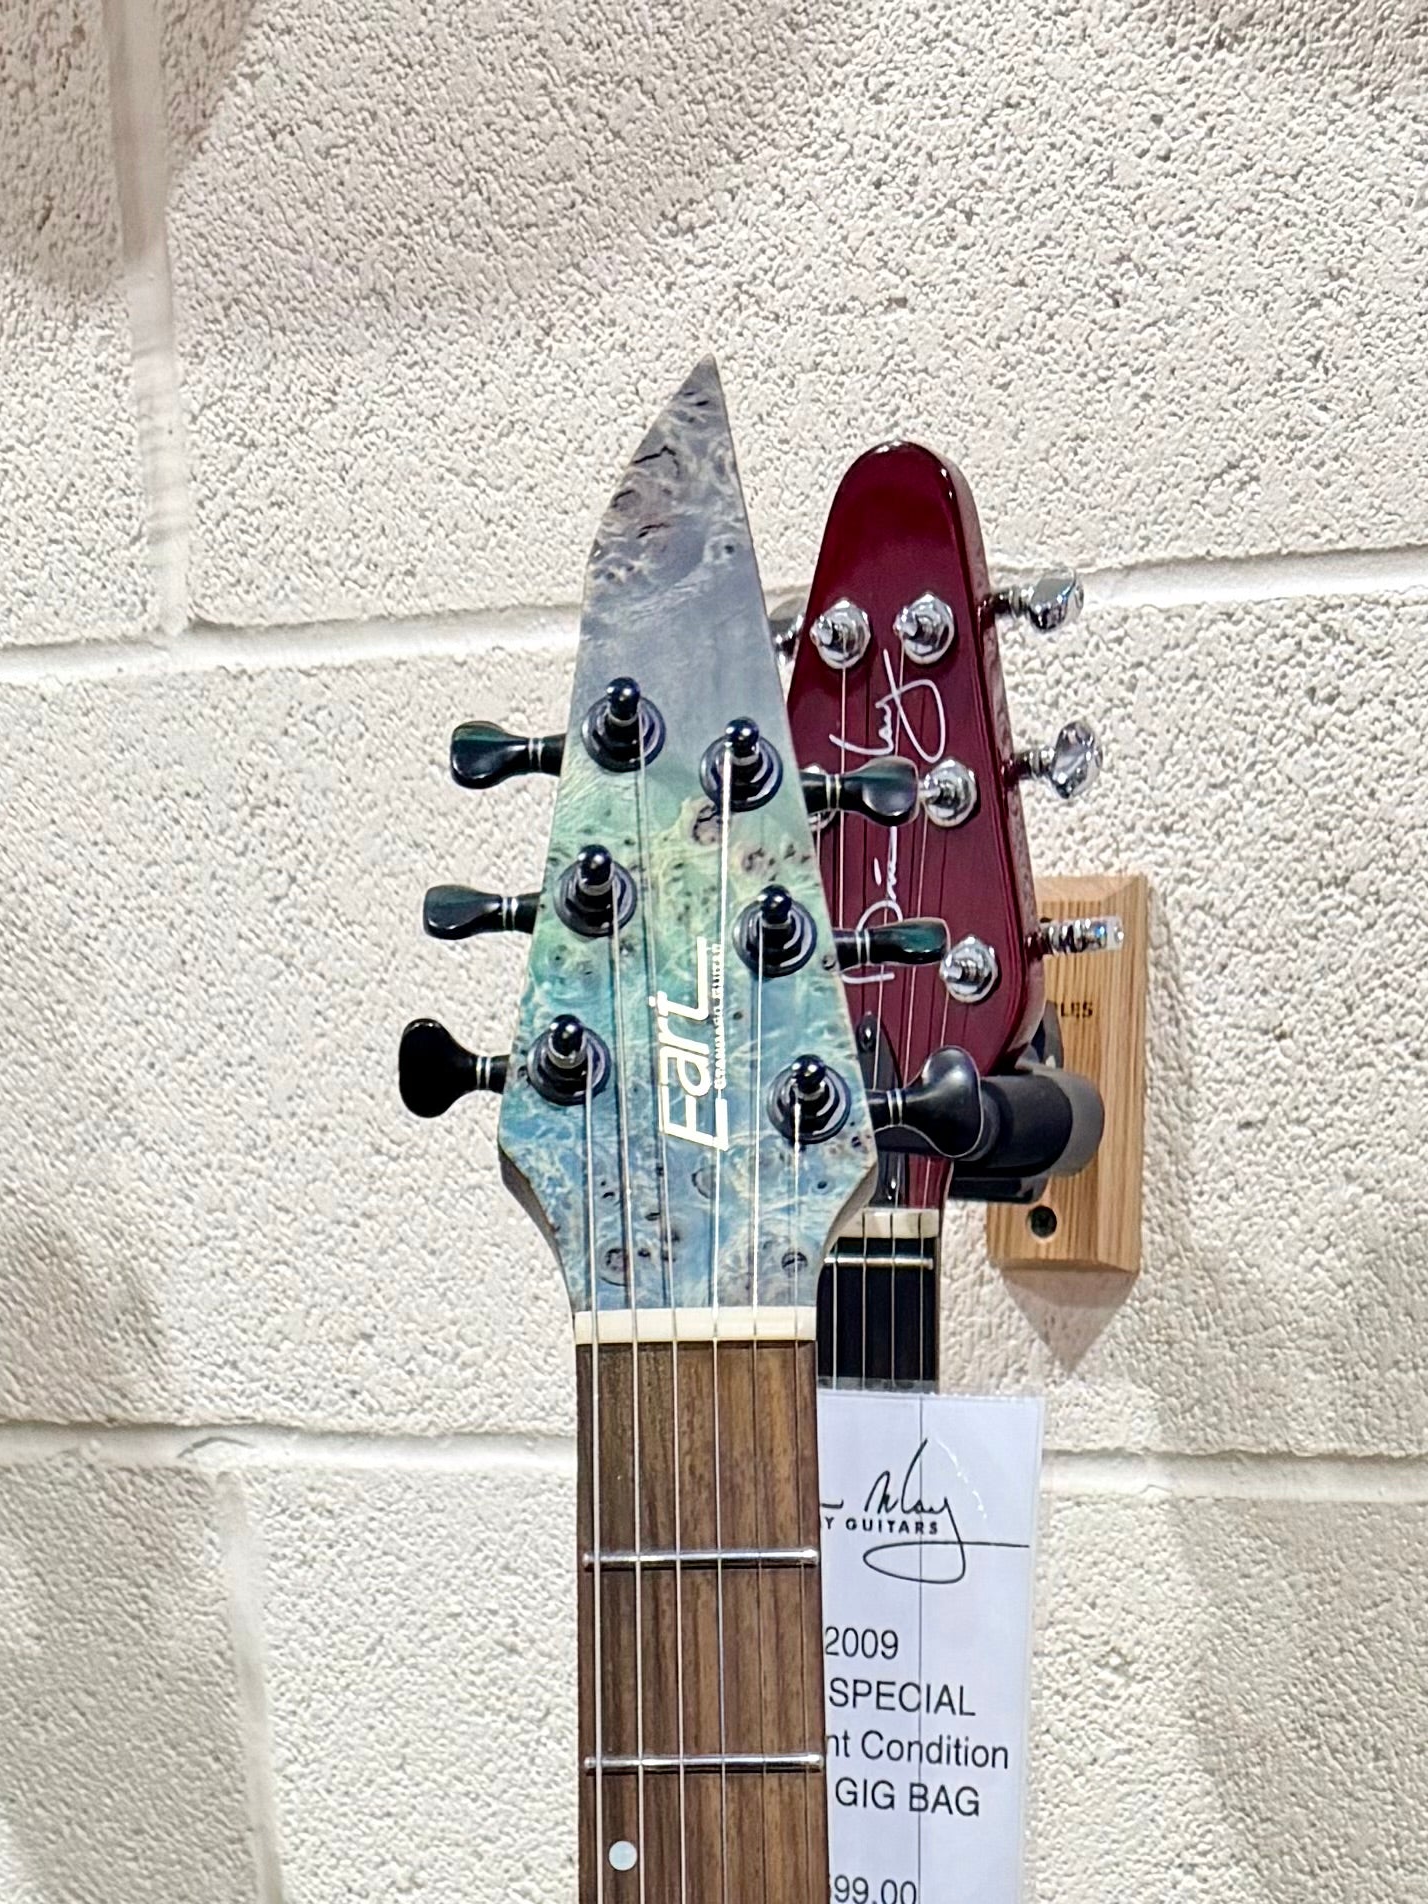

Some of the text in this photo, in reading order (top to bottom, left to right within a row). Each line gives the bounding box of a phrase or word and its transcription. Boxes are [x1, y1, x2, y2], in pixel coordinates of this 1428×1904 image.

[845, 1518, 938, 1535] GUITARS
[825, 1626, 899, 1660] 2009
[829, 1677, 976, 1717] SPECIAL
[861, 1730, 1009, 1770] Condition
[834, 1780, 980, 1817] GIG BAG
